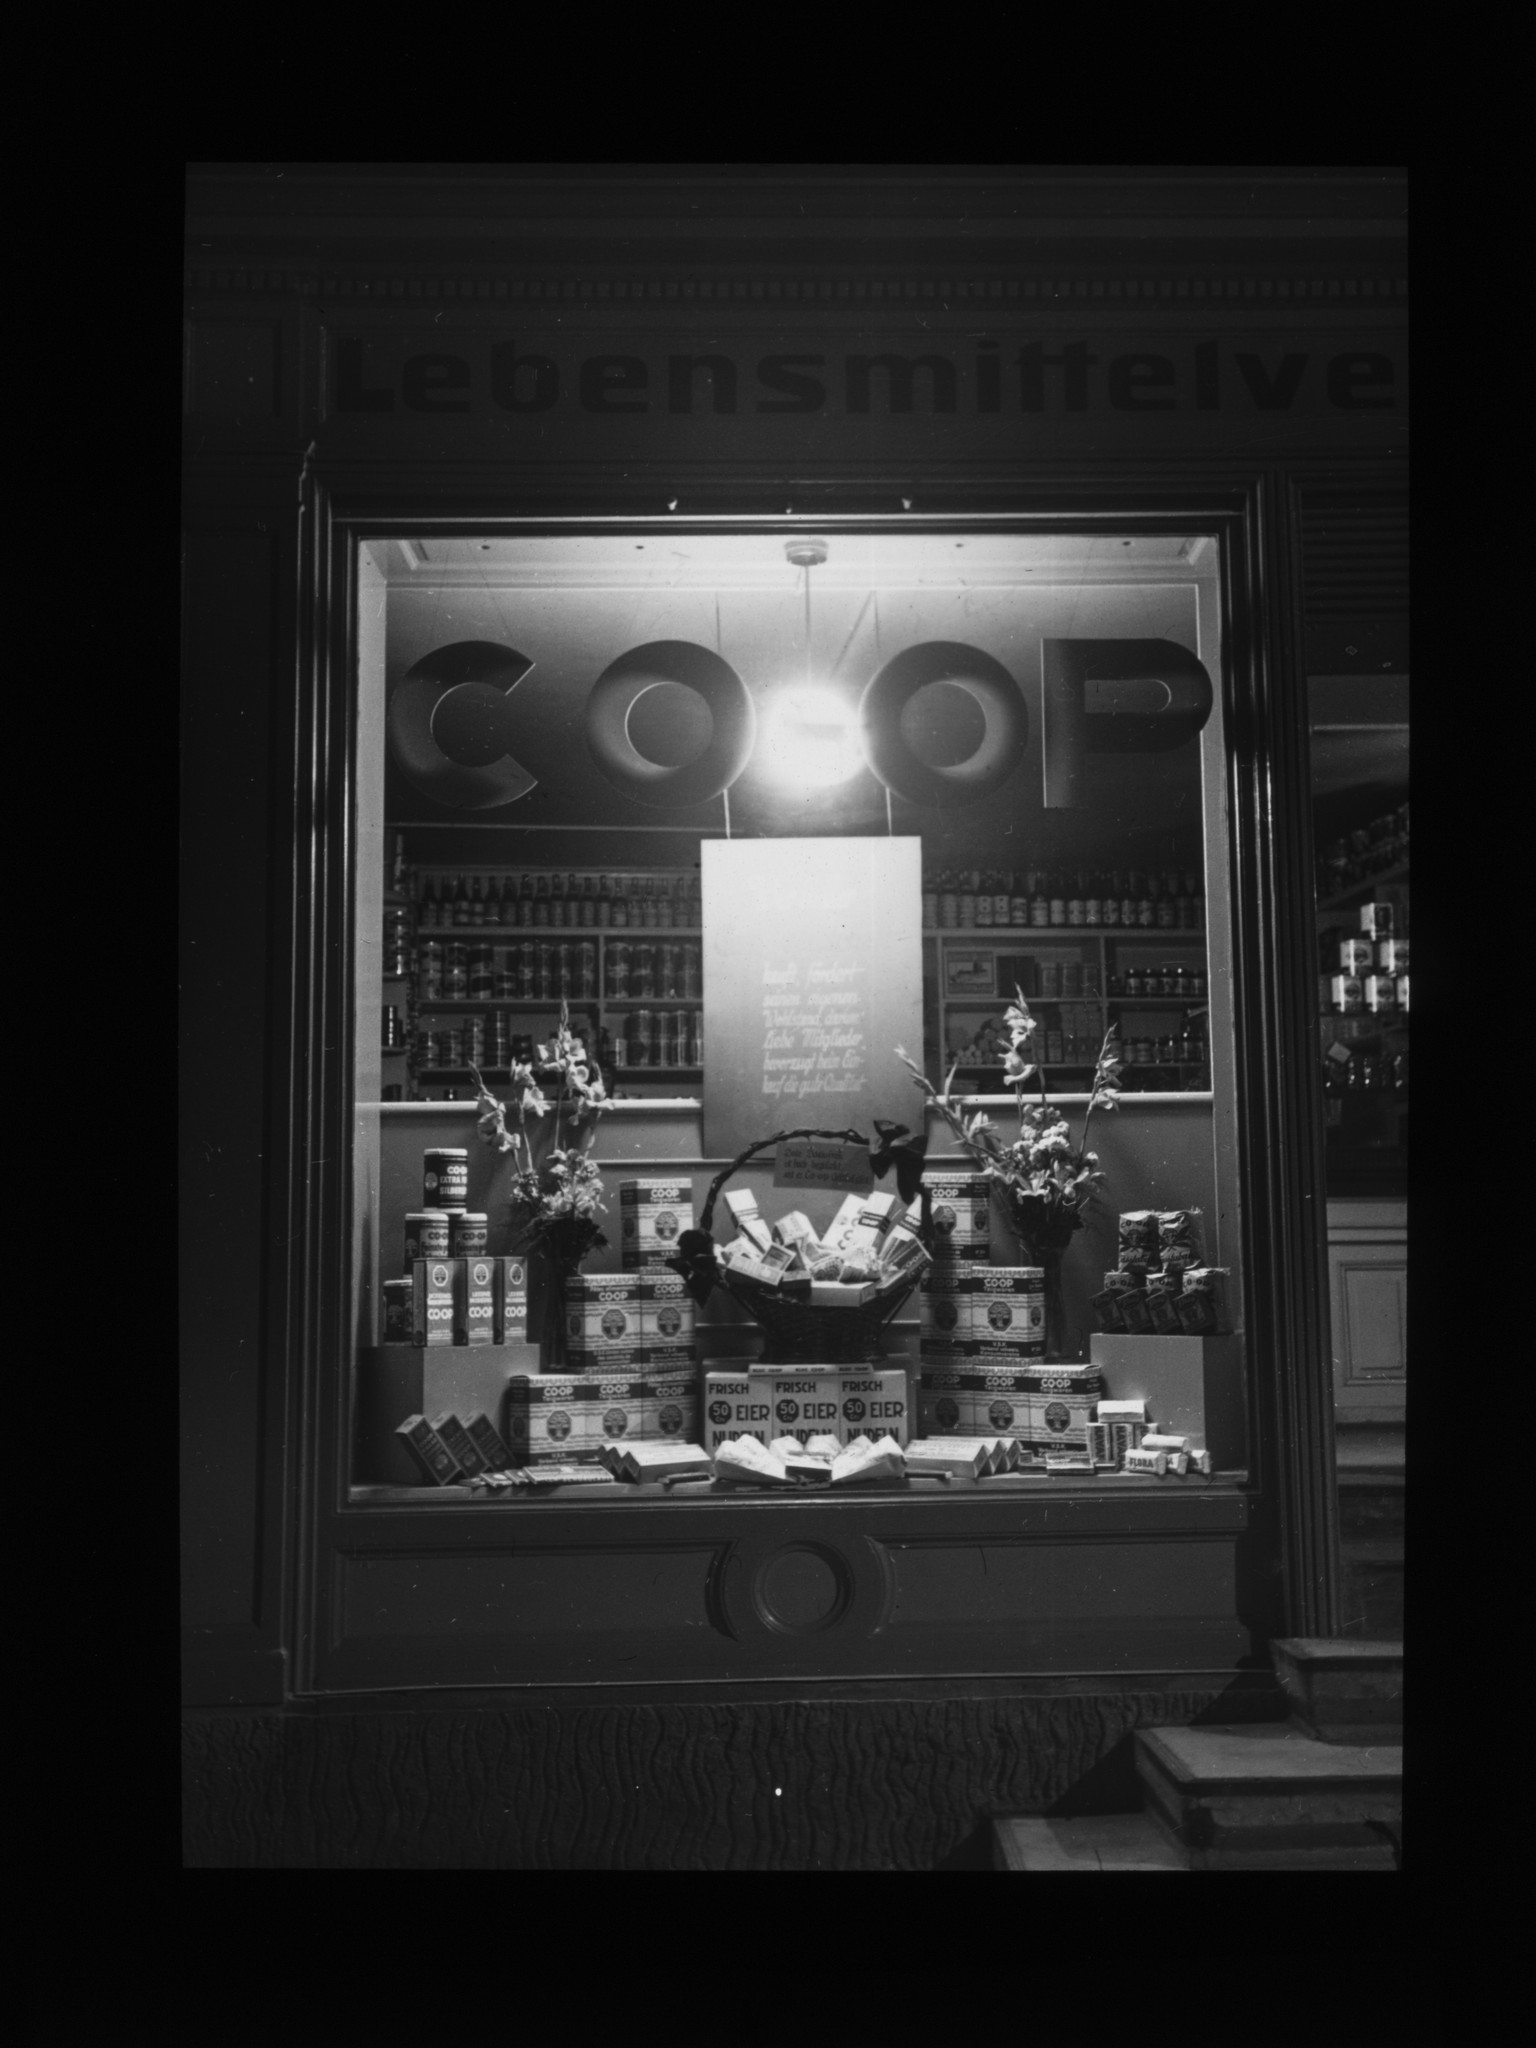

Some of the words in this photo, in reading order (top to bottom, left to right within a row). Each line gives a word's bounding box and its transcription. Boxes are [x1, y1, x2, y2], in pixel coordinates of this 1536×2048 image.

[709, 1383, 749, 1395] FRISCH
[776, 1382, 816, 1393] FRISCH
[842, 1380, 882, 1392] FRISCH
[712, 1404, 729, 1416] 50
[736, 1404, 770, 1421] EIER
[779, 1402, 796, 1415] 50
[804, 1402, 837, 1420] EIER
[846, 1401, 864, 1414] 50
[871, 1401, 904, 1418] EIER
[1129, 1457, 1154, 1468] FLORA
